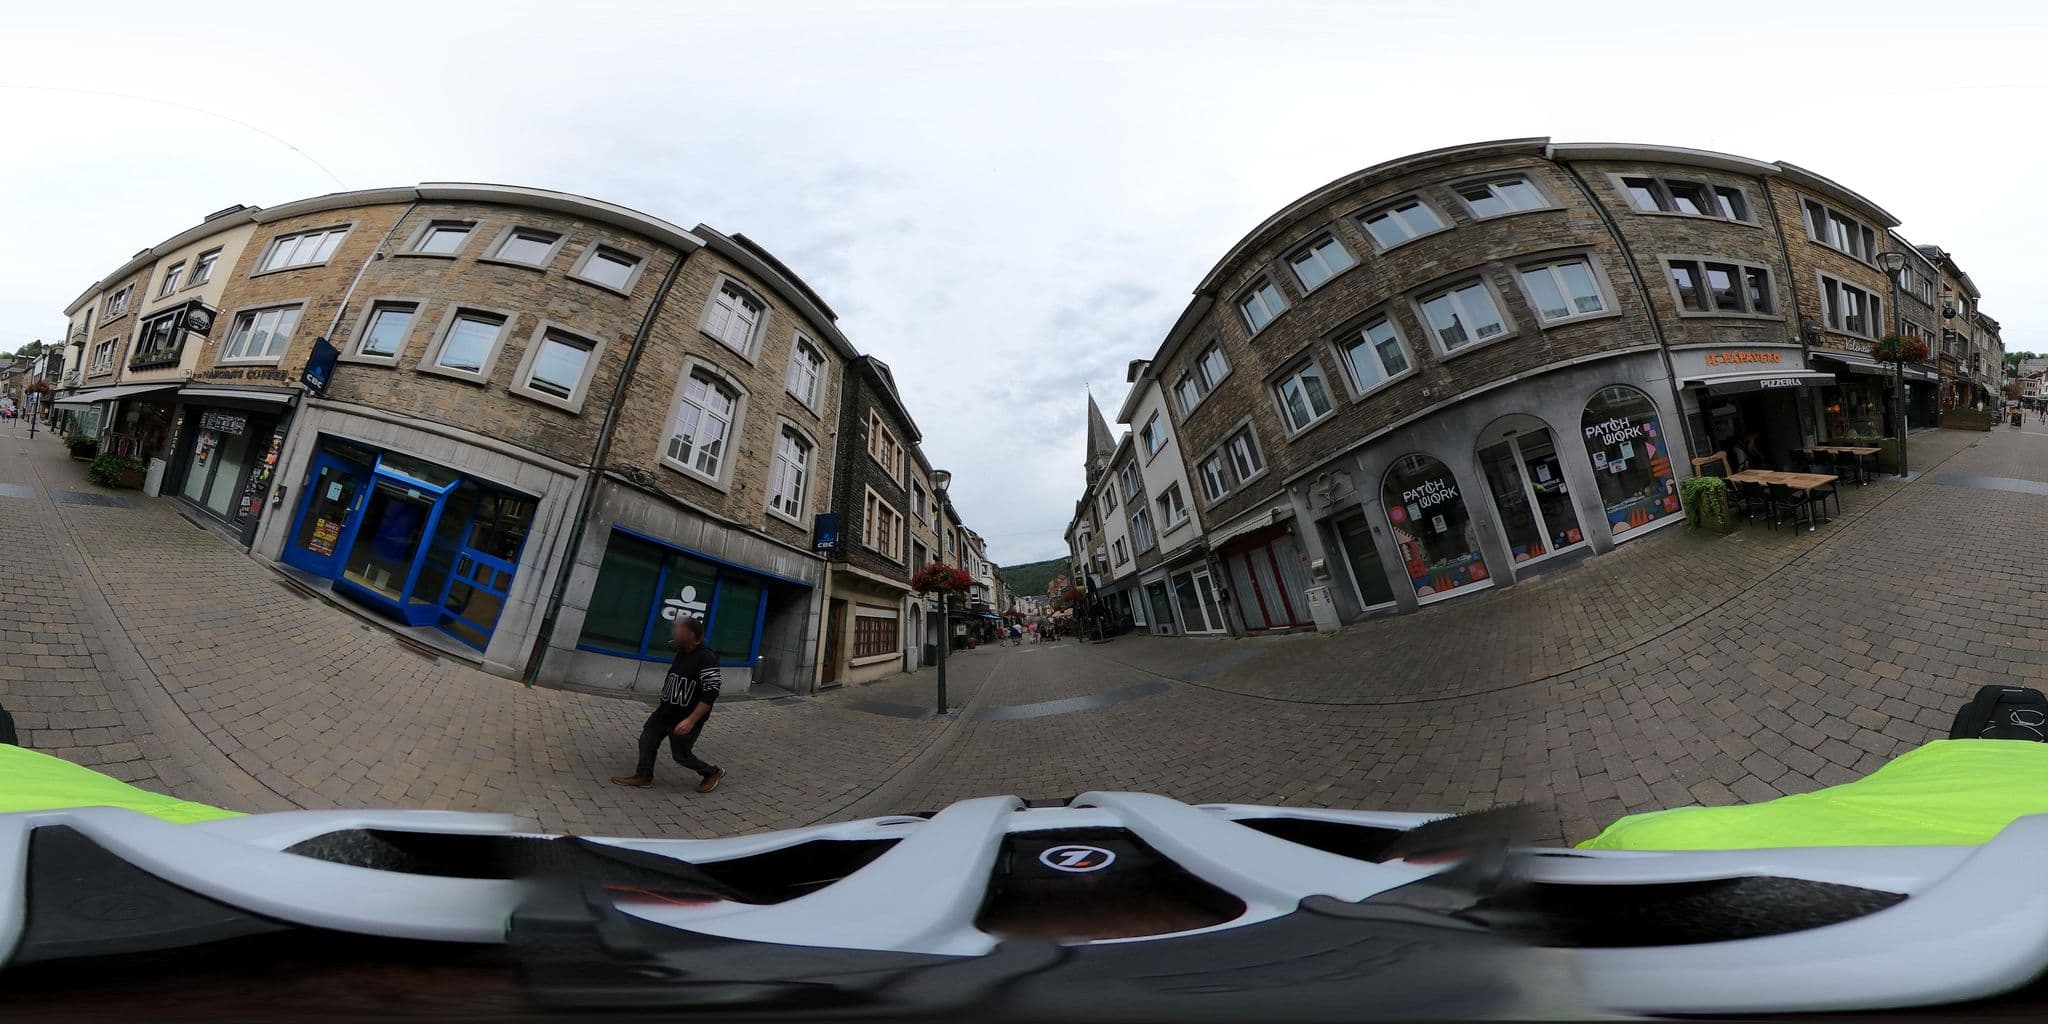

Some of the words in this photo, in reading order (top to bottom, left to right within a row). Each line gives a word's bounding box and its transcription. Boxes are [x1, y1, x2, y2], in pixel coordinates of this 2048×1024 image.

[1722, 351, 1781, 364] PAPAVERO
[306, 373, 323, 389] CBC
[1760, 378, 1802, 389] PIZZERIA
[1585, 417, 1630, 439] PATCH
[1602, 425, 1642, 446] WORK
[1403, 478, 1445, 503] PATCH
[1419, 485, 1458, 508] WORK
